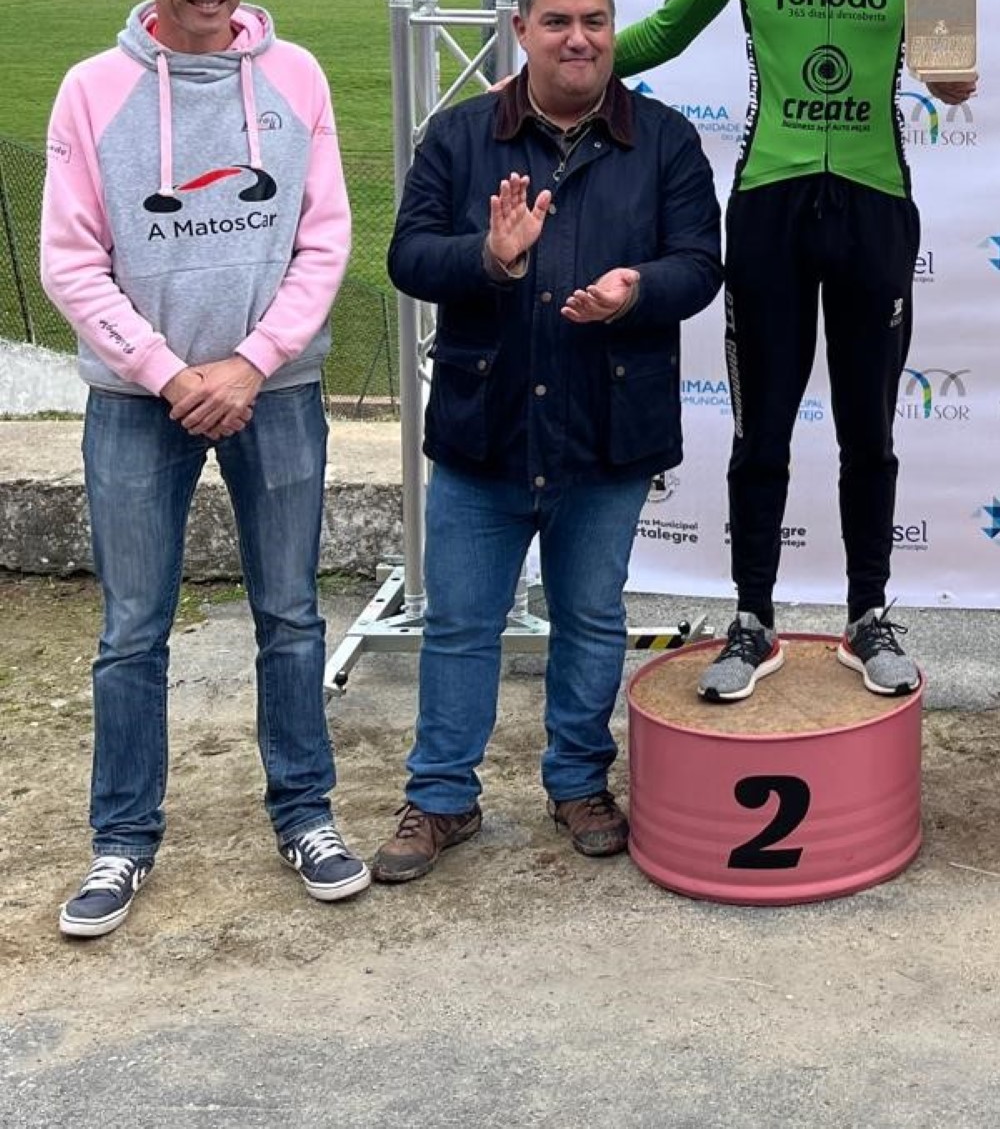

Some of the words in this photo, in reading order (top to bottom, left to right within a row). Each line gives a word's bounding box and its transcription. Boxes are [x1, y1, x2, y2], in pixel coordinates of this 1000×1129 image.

[783, 96, 870, 122] create
[147, 223, 166, 241] A
[174, 211, 277, 239] MatosCar
[682, 380, 728, 393] IMAA
[728, 775, 811, 869] 2
